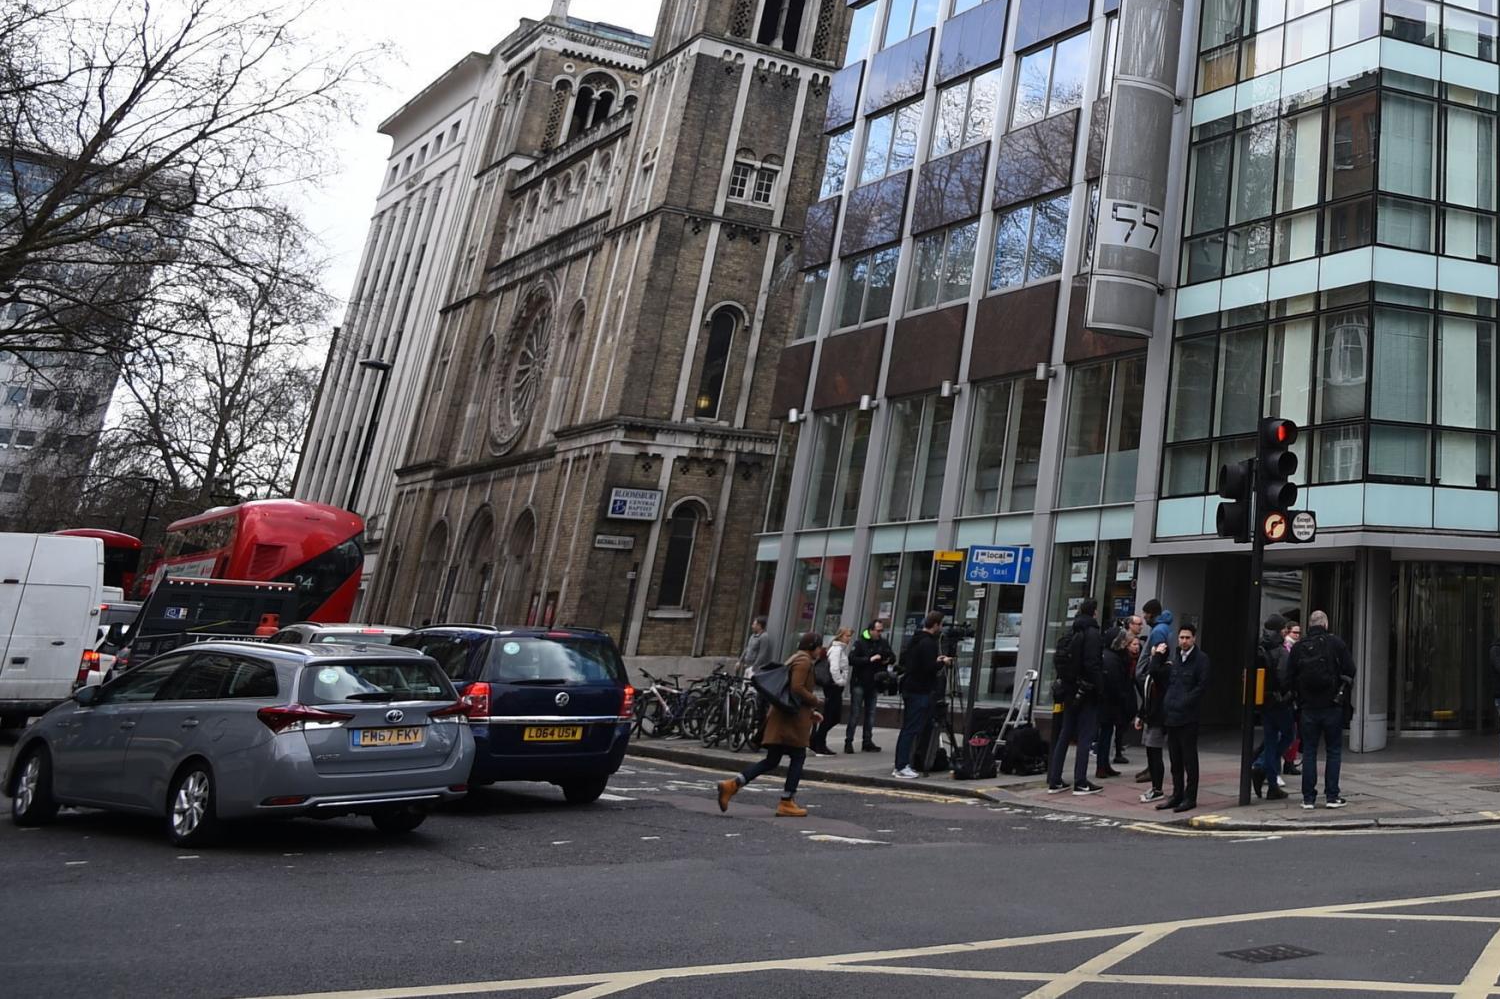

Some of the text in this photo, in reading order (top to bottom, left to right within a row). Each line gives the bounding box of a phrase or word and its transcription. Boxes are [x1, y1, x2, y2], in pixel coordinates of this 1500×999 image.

[1112, 202, 1160, 249] 55
[614, 489, 657, 500] BLOOMSBURY
[987, 550, 1006, 559] local
[993, 567, 1008, 575] taxi
[362, 728, 420, 743] FM67 FKY
[557, 727, 578, 738] USW
